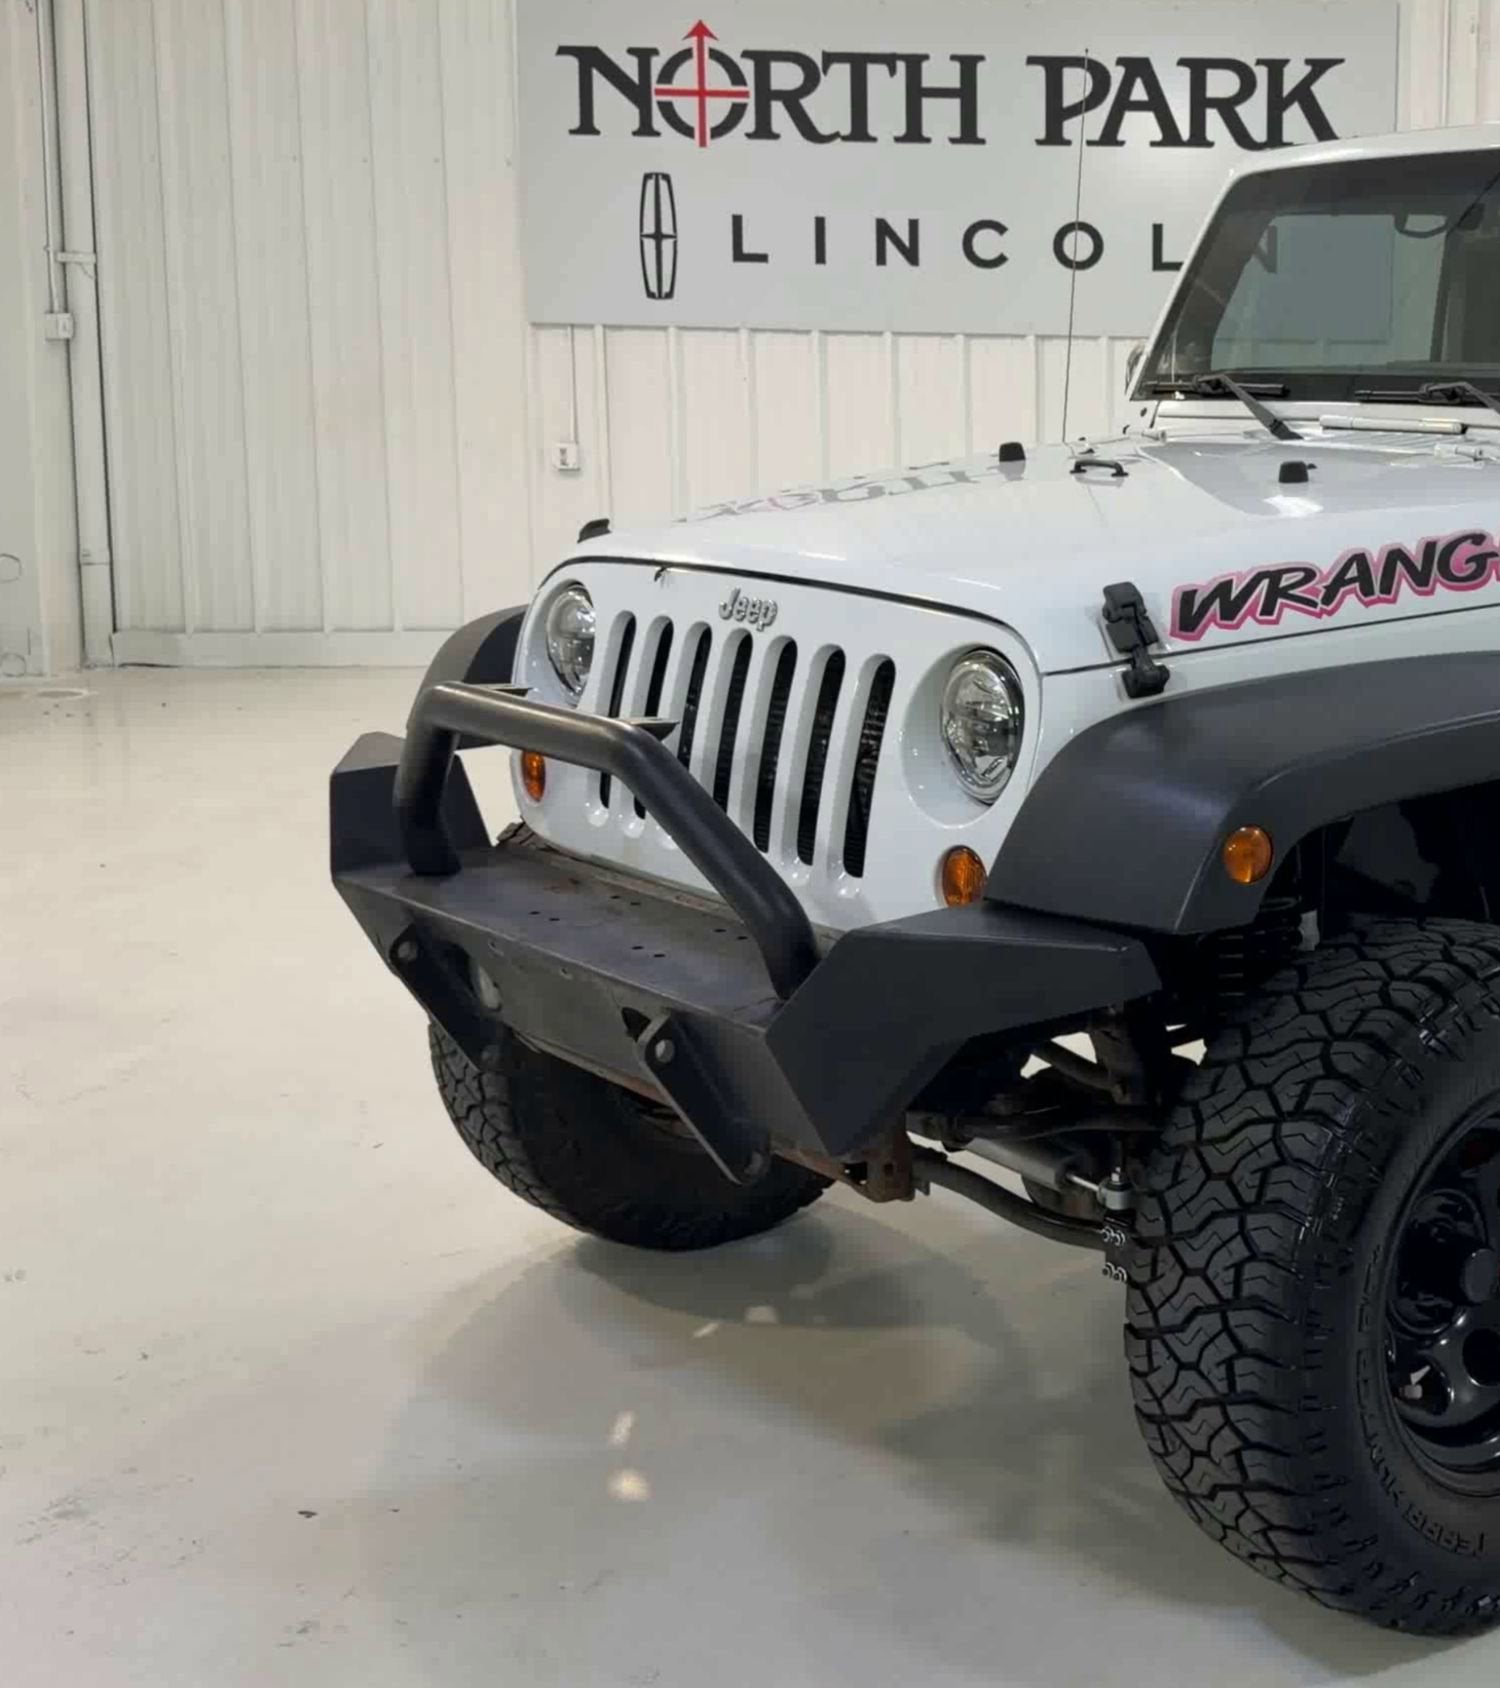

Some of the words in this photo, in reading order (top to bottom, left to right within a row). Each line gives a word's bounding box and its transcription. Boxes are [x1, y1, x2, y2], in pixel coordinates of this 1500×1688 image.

[556, 44, 987, 148] NORTH
[1026, 55, 1346, 151] PARK
[718, 587, 778, 632] Jeep
